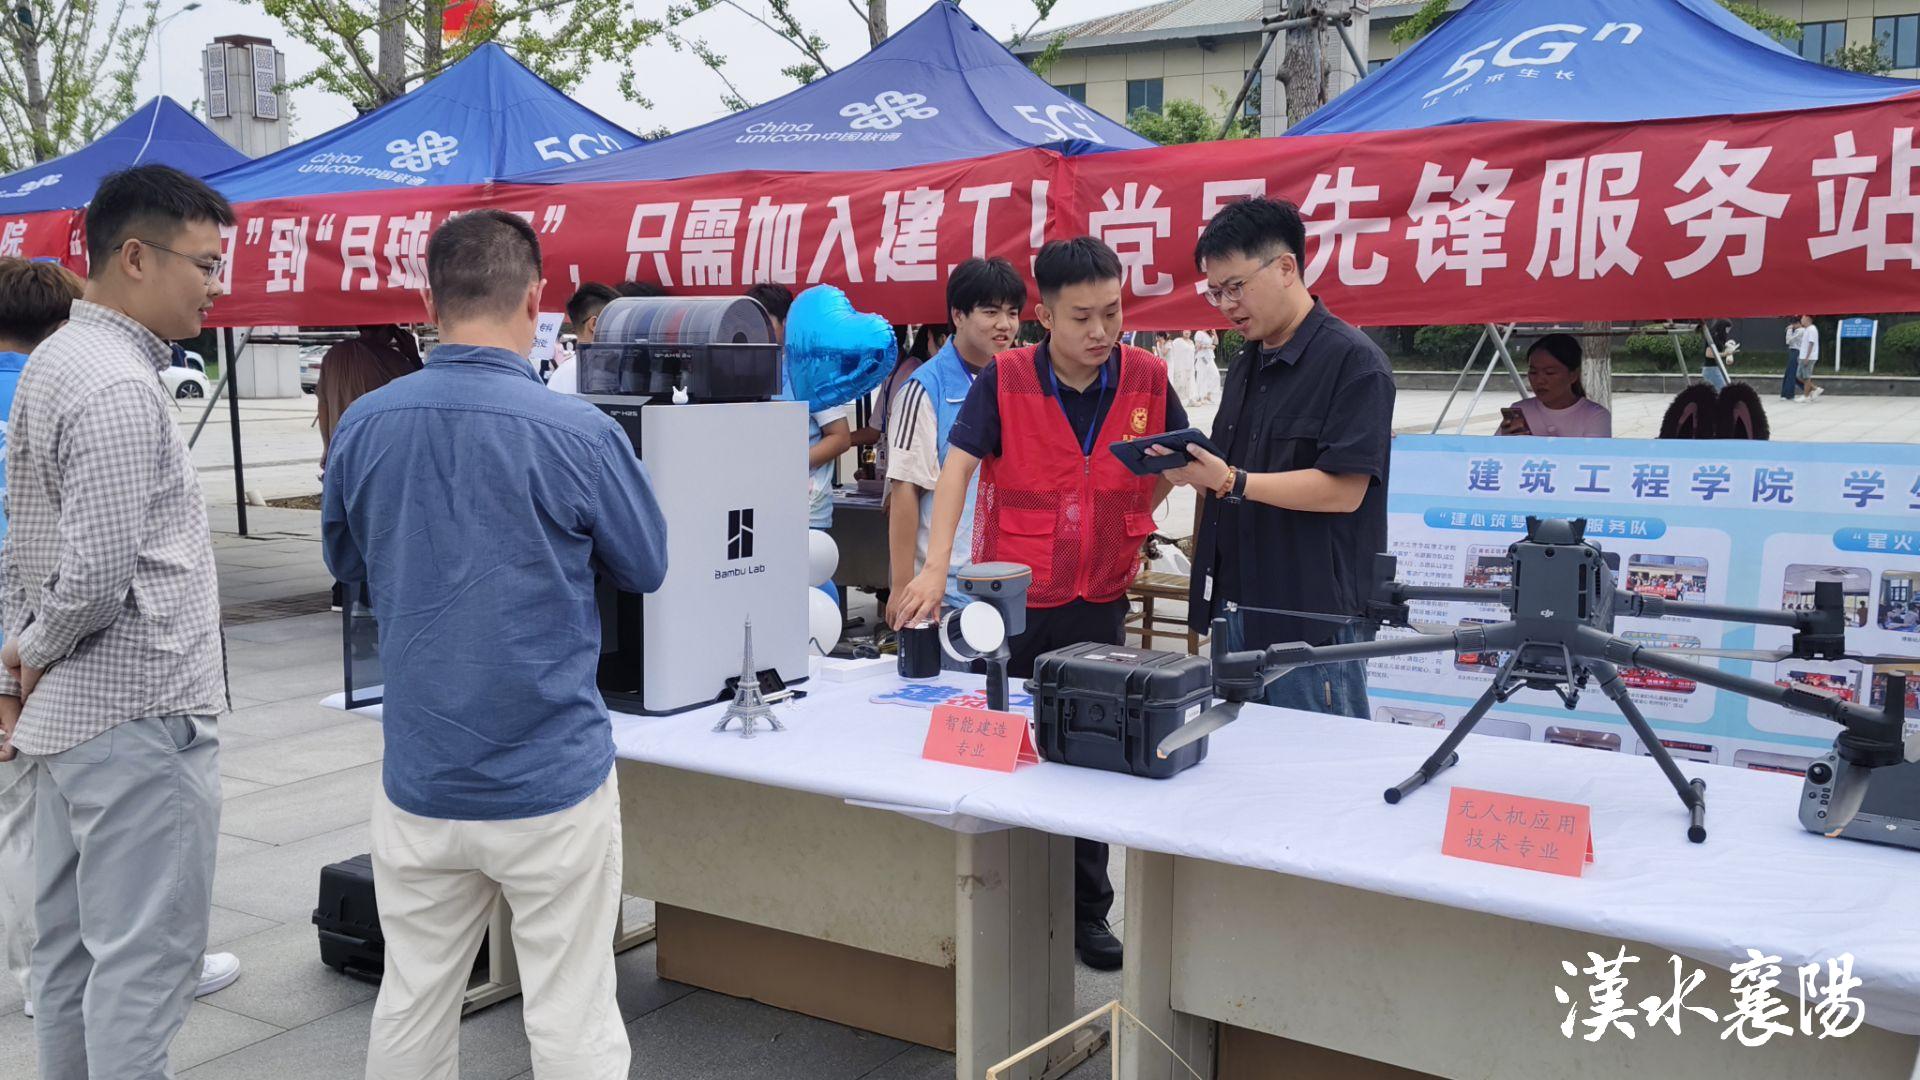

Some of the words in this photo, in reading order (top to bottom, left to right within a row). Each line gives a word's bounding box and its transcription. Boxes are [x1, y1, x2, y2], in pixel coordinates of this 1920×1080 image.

[745, 122, 814, 133] China
[1, 219, 28, 257] 院
[1468, 457, 1794, 504] 建筑工程学院
[1842, 469, 1920, 510] 学
[1439, 510, 1649, 537] “建心筑梦服务队
[714, 567, 746, 580] Bambu
[748, 564, 765, 574] Lab
[946, 715, 1007, 738] 智能建造
[956, 741, 985, 757] 专业
[1459, 802, 1577, 835] 无人机应用
[1464, 827, 1560, 861] 技术专业
